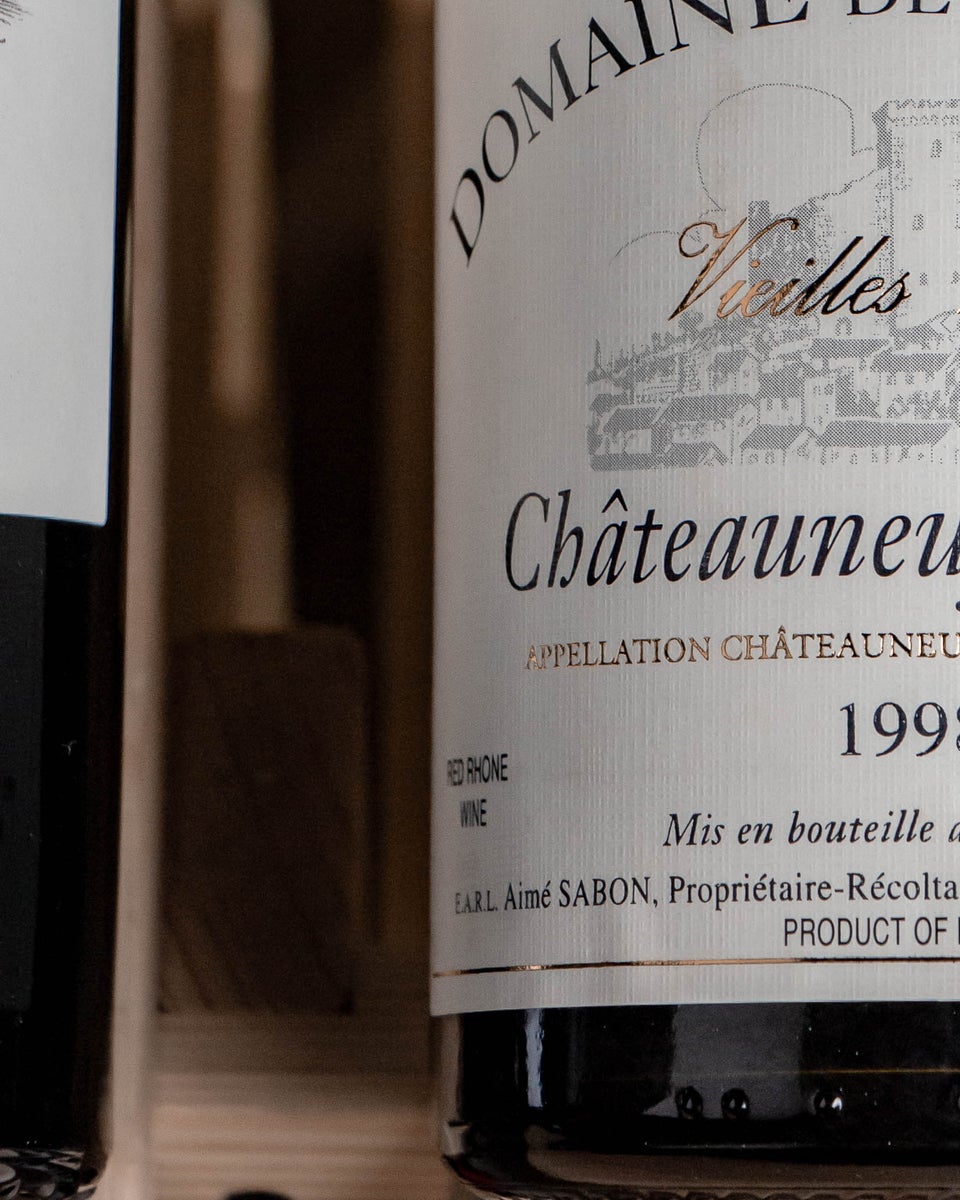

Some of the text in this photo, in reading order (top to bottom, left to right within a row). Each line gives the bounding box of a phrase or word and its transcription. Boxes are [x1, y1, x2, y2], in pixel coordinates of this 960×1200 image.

[668, 216, 912, 321] Vieilles
[525, 636, 711, 670] APPELLATION
[447, 753, 508, 786] RED RHONE
[460, 799, 487, 827] WINE
[663, 813, 724, 846] Mis
[738, 821, 773, 844] en
[788, 809, 934, 844] bouteille
[455, 889, 498, 915] E.A.R.L.
[504, 880, 551, 911] Aimé
[559, 876, 658, 908] SABON,
[784, 917, 906, 947] PRODUCT
[914, 917, 947, 946] OF
